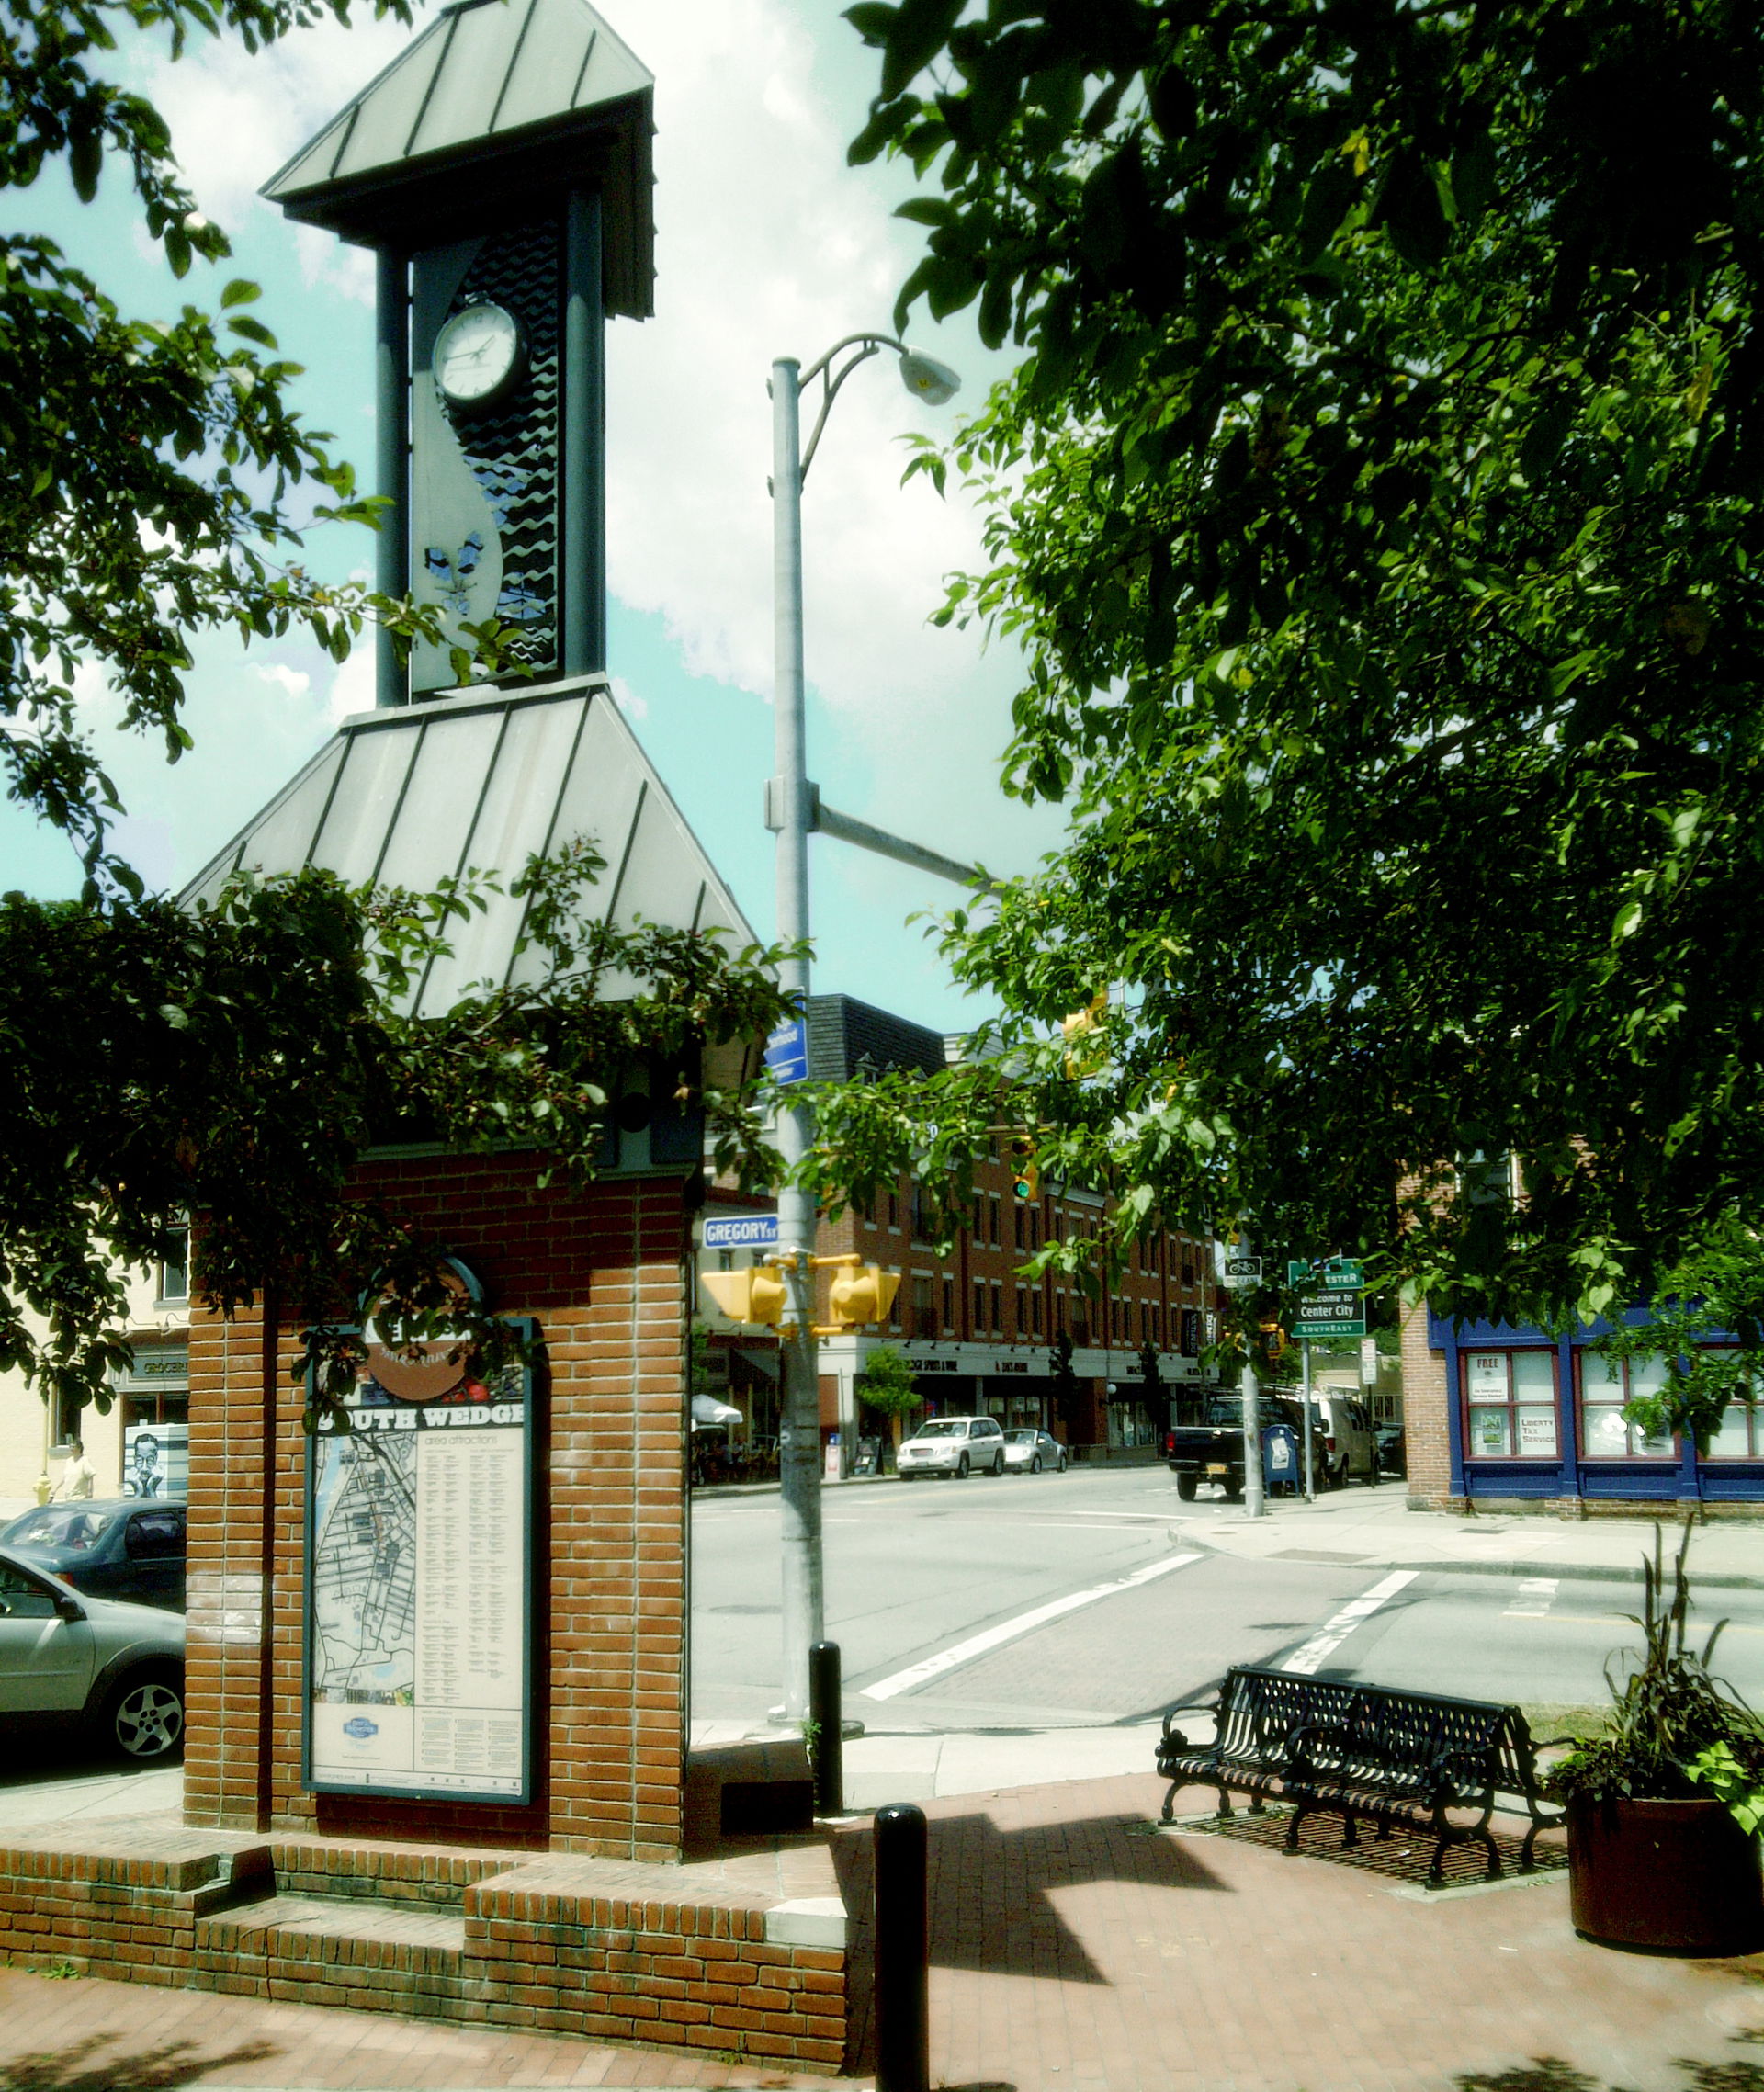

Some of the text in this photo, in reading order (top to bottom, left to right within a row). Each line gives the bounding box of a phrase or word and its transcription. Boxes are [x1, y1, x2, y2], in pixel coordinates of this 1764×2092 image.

[707, 1221, 767, 1241] GREGORY
[1344, 1294, 1353, 1302] to
[1300, 1305, 1354, 1318] Center City
[1477, 1358, 1498, 1368] FREE
